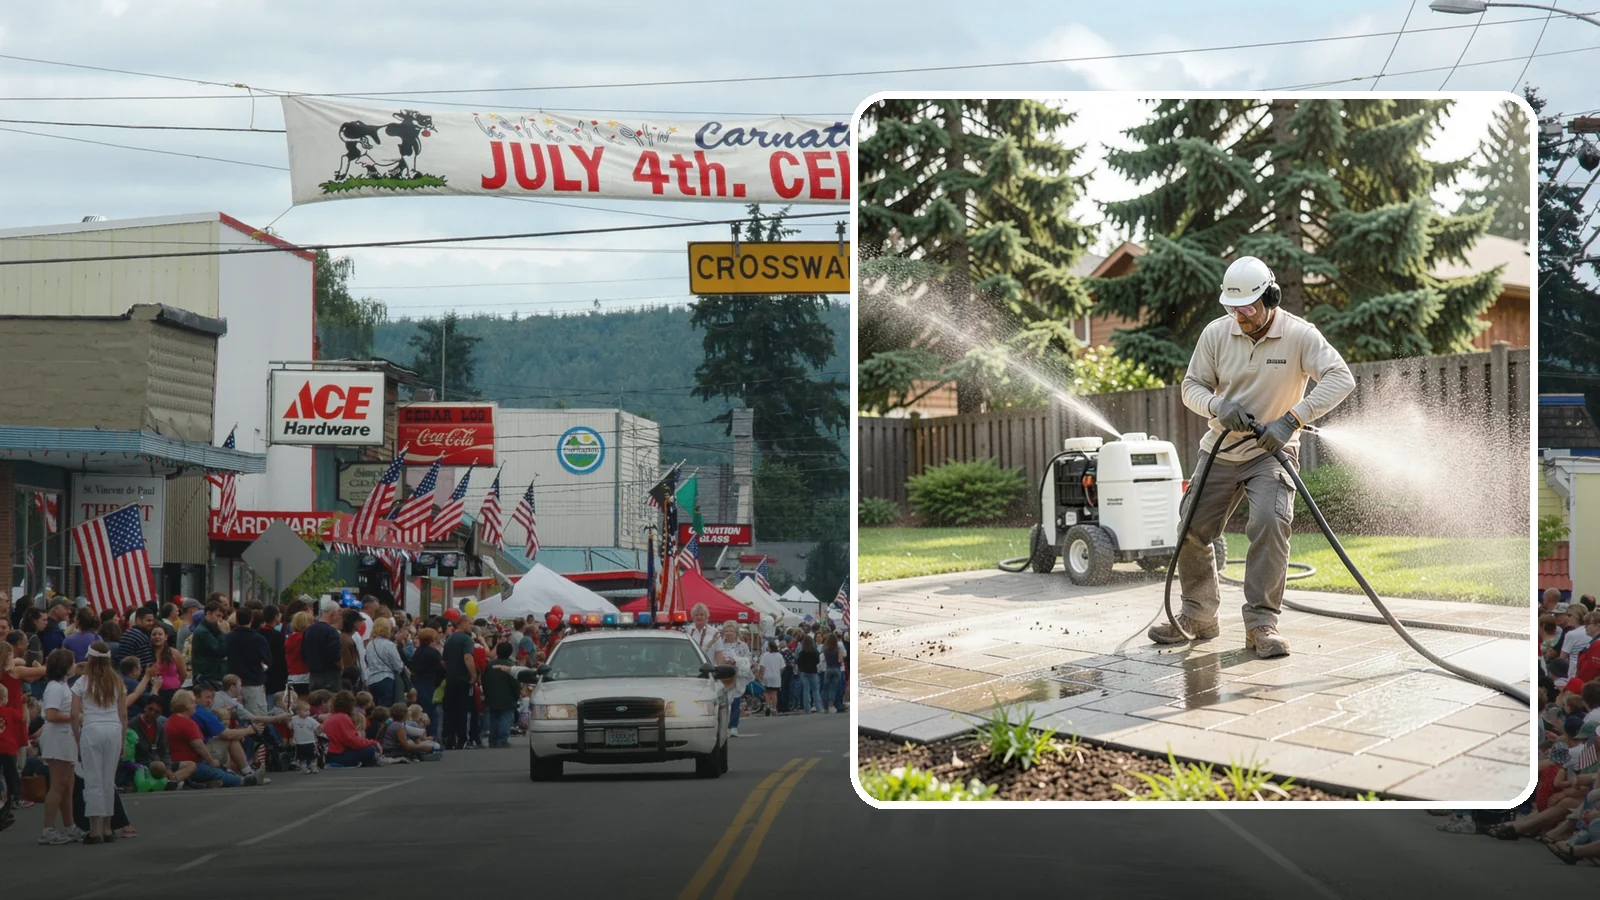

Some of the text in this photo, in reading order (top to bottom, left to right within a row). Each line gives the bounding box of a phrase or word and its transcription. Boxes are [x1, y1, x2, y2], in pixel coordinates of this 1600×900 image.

[481, 140, 604, 192] JULY
[632, 150, 746, 197] 4th.
[697, 254, 850, 280] CROSSWA
[282, 380, 373, 420] ACE
[406, 409, 485, 421] CEDAR LOG
[283, 421, 371, 437] Hardware
[416, 428, 475, 447] Coca-Cola
[354, 467, 385, 481] Simpl
[83, 485, 155, 495] St. Vincent de Paul
[688, 526, 741, 535] CRNATION
[699, 535, 730, 543] GLASS
